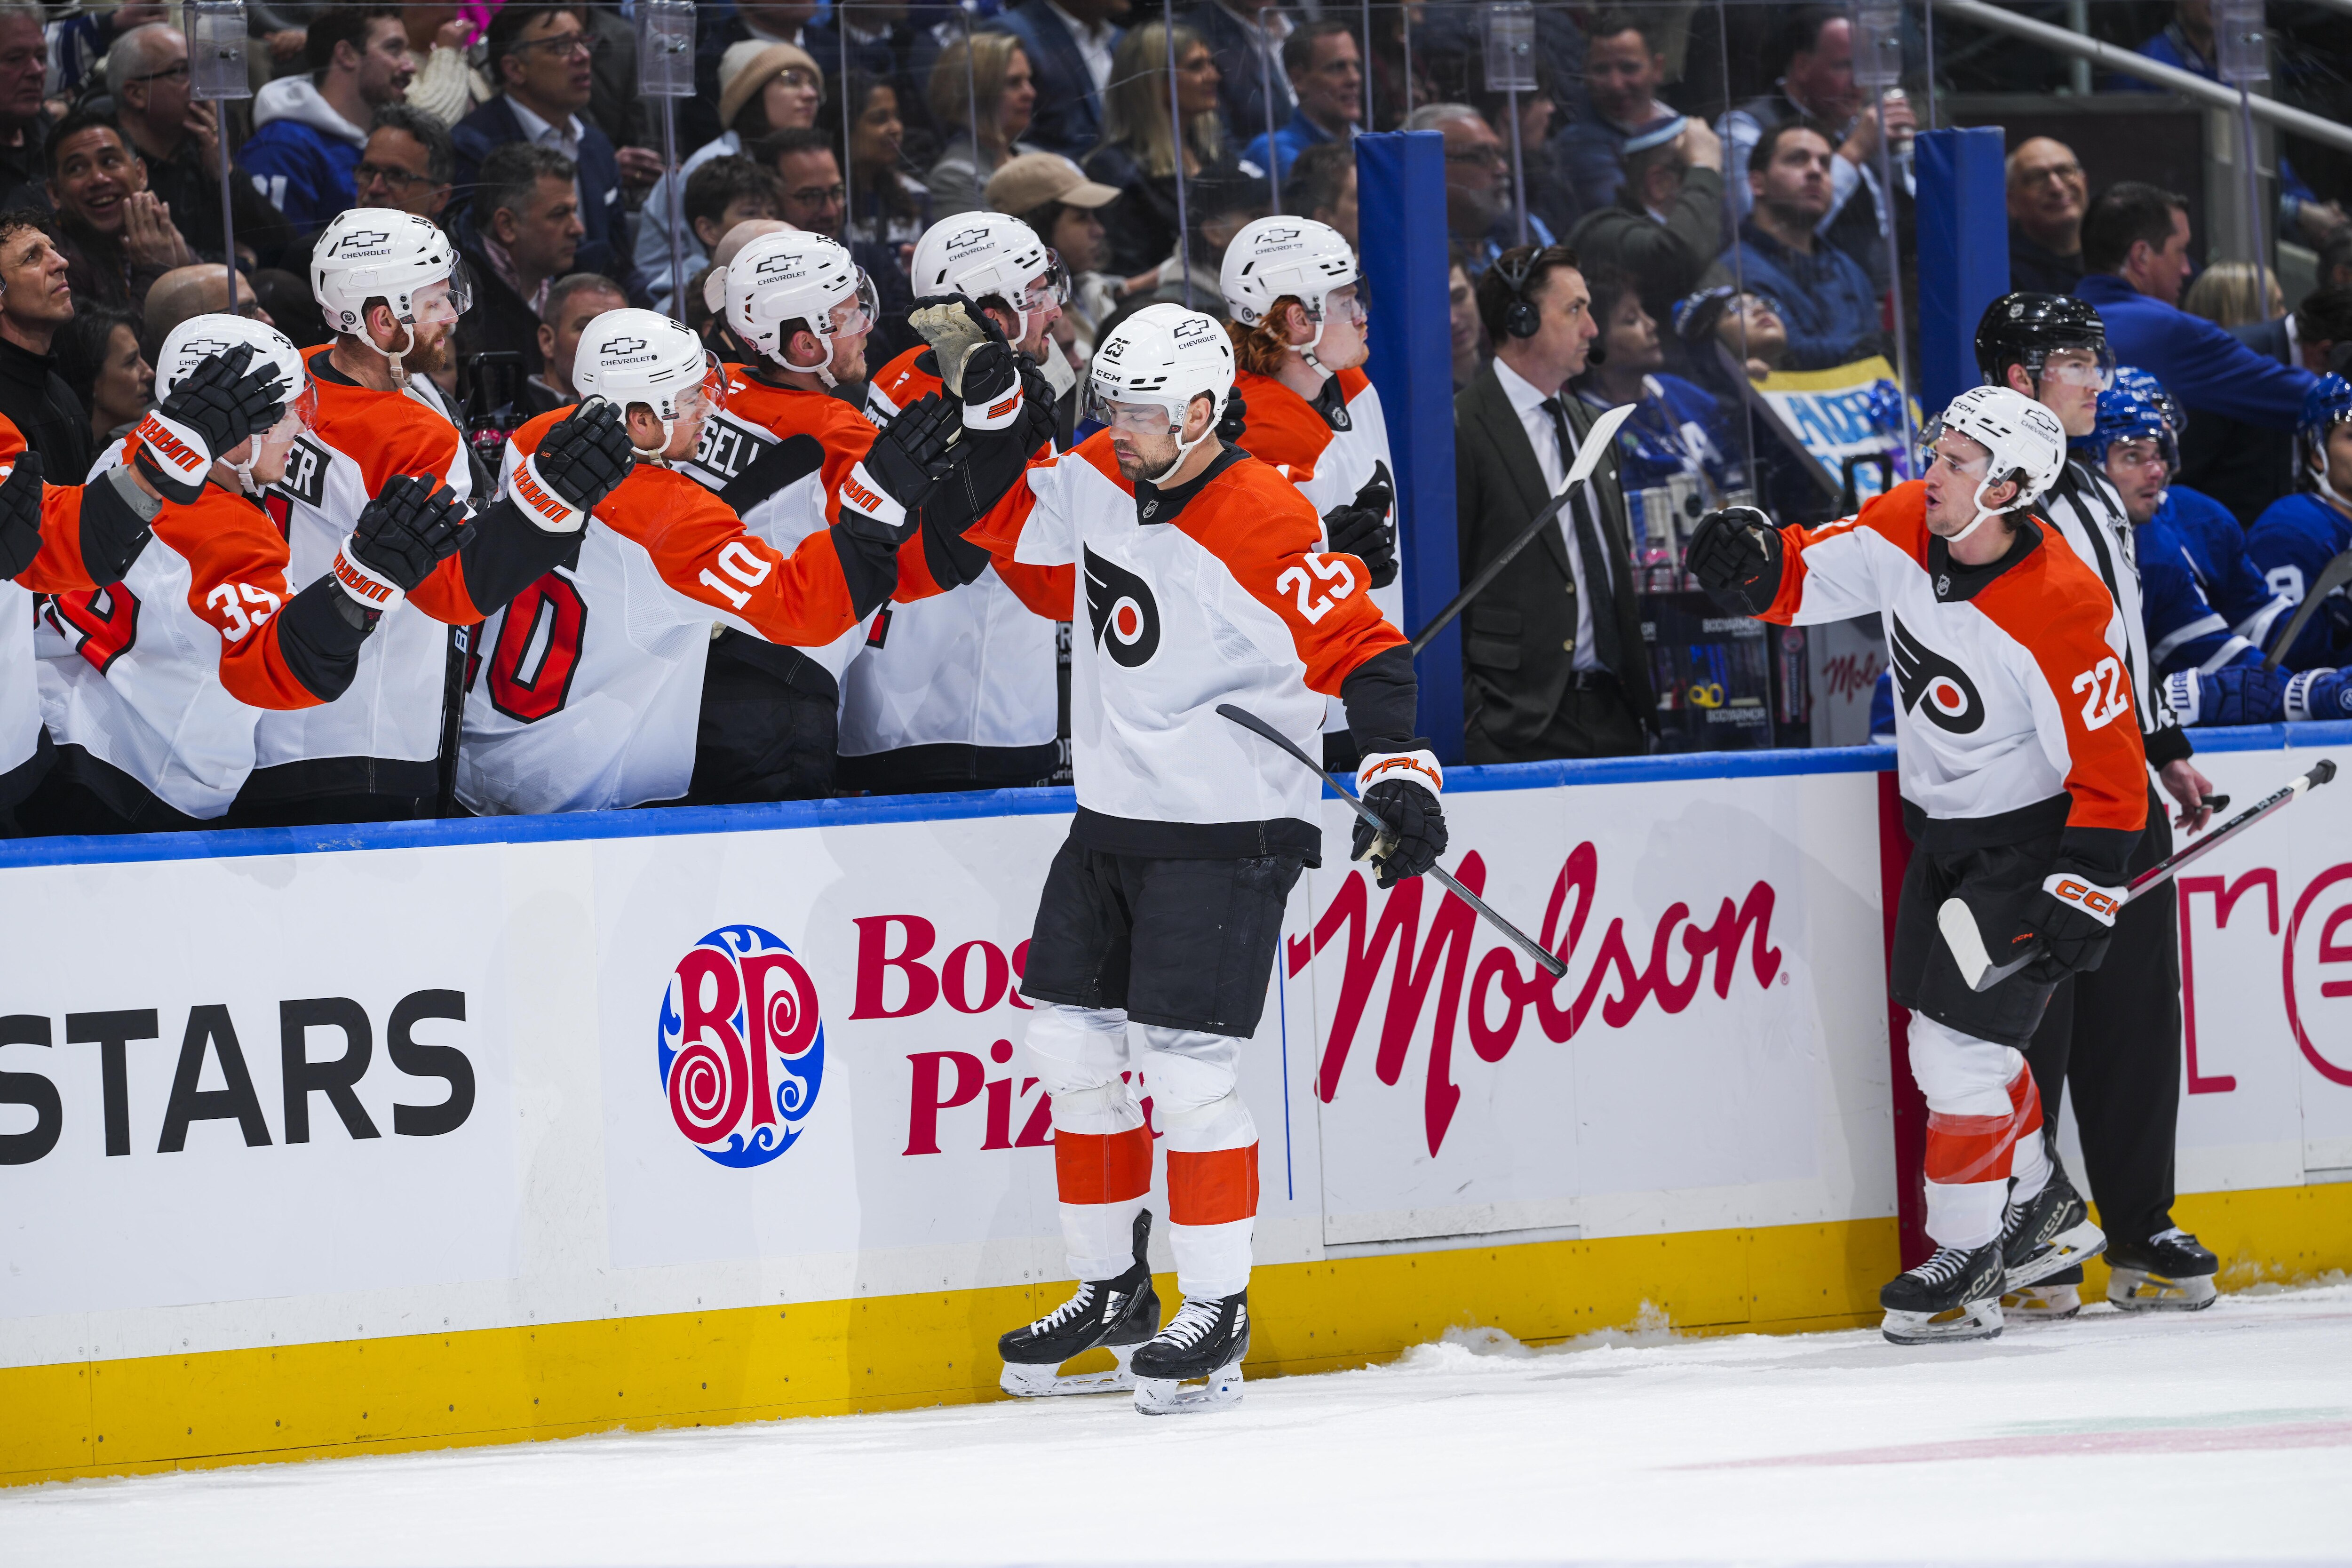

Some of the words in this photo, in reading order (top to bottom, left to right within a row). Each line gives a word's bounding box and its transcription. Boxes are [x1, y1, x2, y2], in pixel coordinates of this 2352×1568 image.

[342, 249, 391, 259] CHEVROLET
[949, 242, 996, 262] CHEVROLET
[1255, 243, 1303, 255] CHEVROLET
[758, 271, 807, 286] CHEVROLET
[670, 320, 690, 335] 10
[1104, 337, 1131, 358] 25
[1178, 334, 1217, 350] CHEVROLET
[601, 356, 651, 366] CHEVROLET
[1096, 368, 1121, 382] CCM
[1954, 401, 1976, 414] CCM
[2021, 420, 2058, 446] CHEVROLET
[699, 542, 771, 610] 10
[1276, 552, 1355, 625] 25
[207, 583, 281, 642] 39
[2072, 656, 2129, 731] 22
[1361, 757, 1441, 792] TRUE
[1364, 813, 1378, 826] CCM
[2056, 880, 2122, 917] CCM
[2013, 933, 2034, 943] CCM
[848, 915, 1035, 1020] Bos
[1288, 841, 1781, 1158] Molson
[669, 944, 819, 1144] BP
[0, 988, 476, 1165] STARS
[902, 1039, 1164, 1156] Piz
[2035, 1202, 2065, 1244] CCM
[1958, 1265, 1998, 1306] CCM
[1078, 1319, 1096, 1333] CUSTOM
